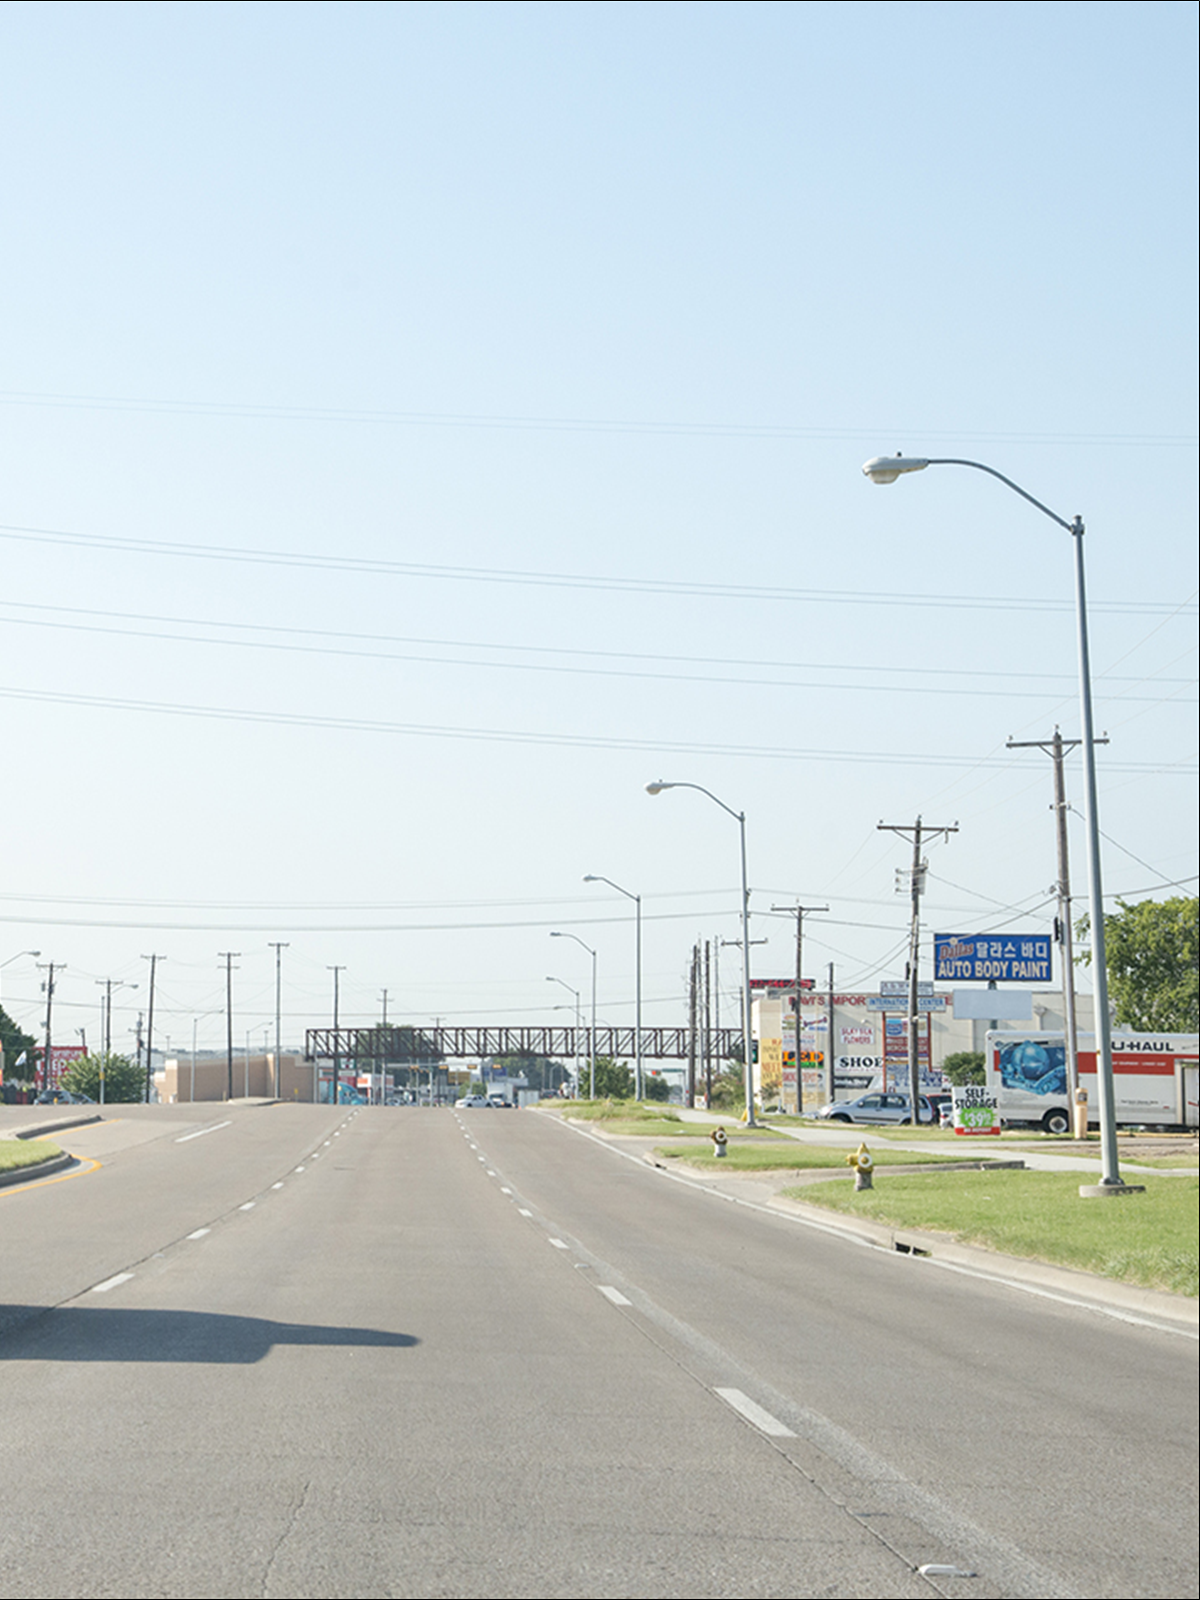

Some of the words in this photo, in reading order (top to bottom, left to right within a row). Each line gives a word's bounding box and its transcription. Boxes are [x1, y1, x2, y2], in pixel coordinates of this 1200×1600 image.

[939, 942, 975, 960] Dallas
[976, 942, 1017, 959] 달라스
[1021, 942, 1048, 959] 바디
[938, 961, 972, 977] AUTO
[974, 961, 1009, 977] BODY
[1012, 961, 1049, 978] PAINT
[954, 1098, 998, 1109] STORAGE
